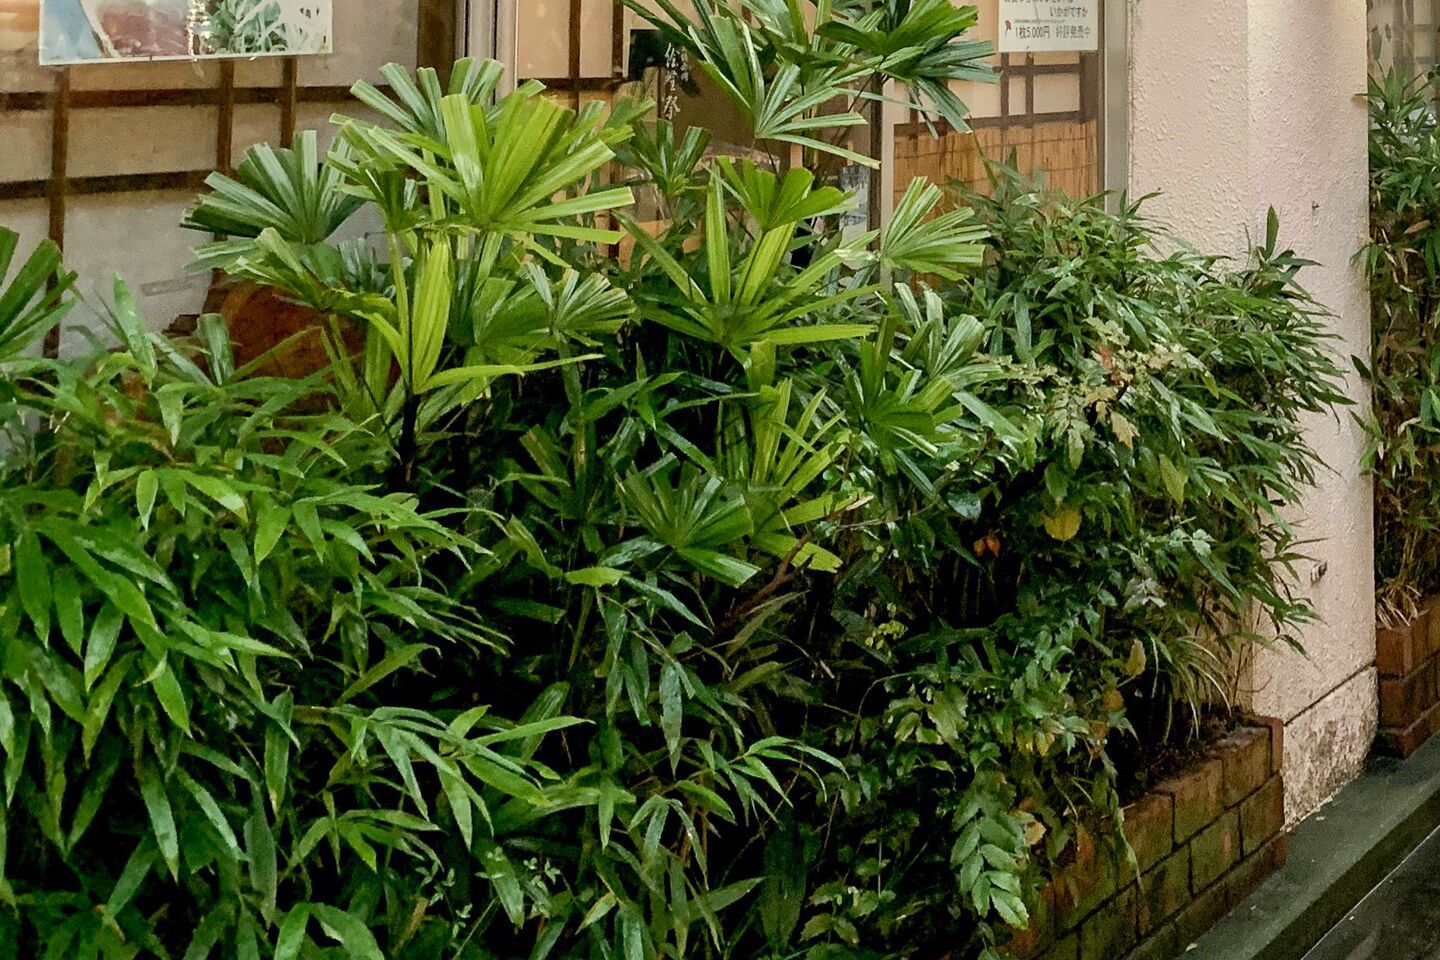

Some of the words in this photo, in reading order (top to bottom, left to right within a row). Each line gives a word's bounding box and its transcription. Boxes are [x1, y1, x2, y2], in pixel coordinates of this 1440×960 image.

[1050, 6, 1089, 19] いかがですか
[1055, 24, 1091, 39] 好評発売中
